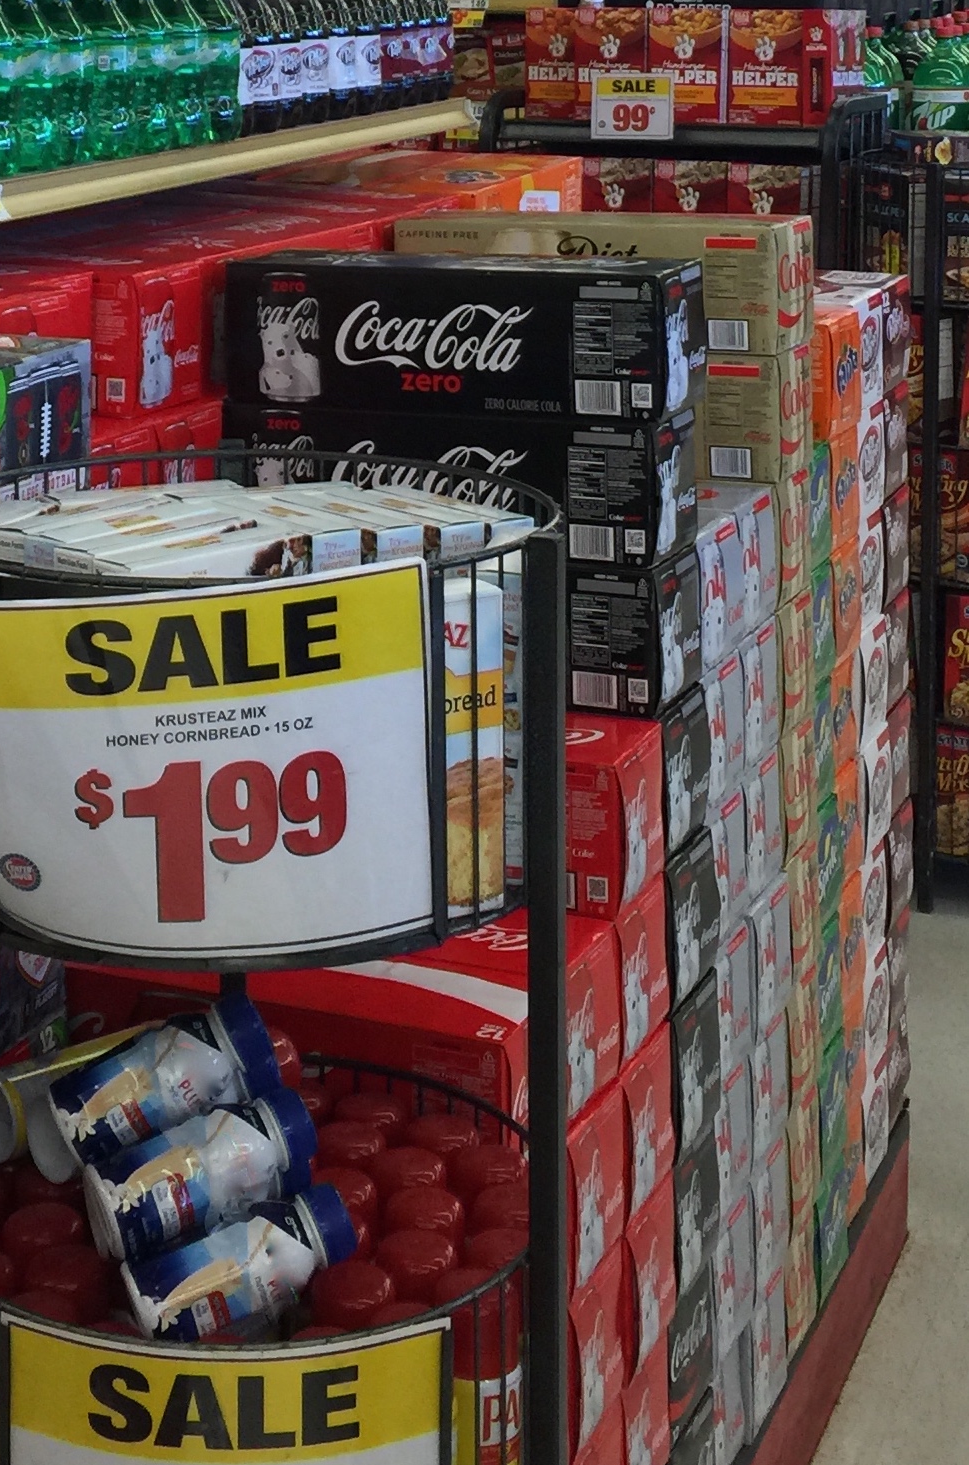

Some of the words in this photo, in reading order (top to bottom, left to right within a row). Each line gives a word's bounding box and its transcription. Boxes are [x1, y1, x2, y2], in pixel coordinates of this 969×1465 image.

[612, 80, 655, 93] SALE
[732, 70, 798, 86] HELPER
[271, 280, 306, 293] zero
[335, 300, 534, 373] Coca-Cola
[402, 371, 461, 393] zero
[485, 398, 505, 411] ZERO
[507, 399, 539, 412] CALORIE
[541, 401, 561, 413] COLA
[266, 417, 300, 430] zero
[64, 595, 340, 697] SALE
[154, 707, 236, 727] KRUSTEAZ
[240, 705, 266, 720] MIX
[105, 730, 159, 747] HONEY
[163, 725, 261, 745] CORNBREAD
[274, 719, 293, 733] 15
[294, 716, 313, 731] OZ
[88, 1364, 360, 1450] SALE
